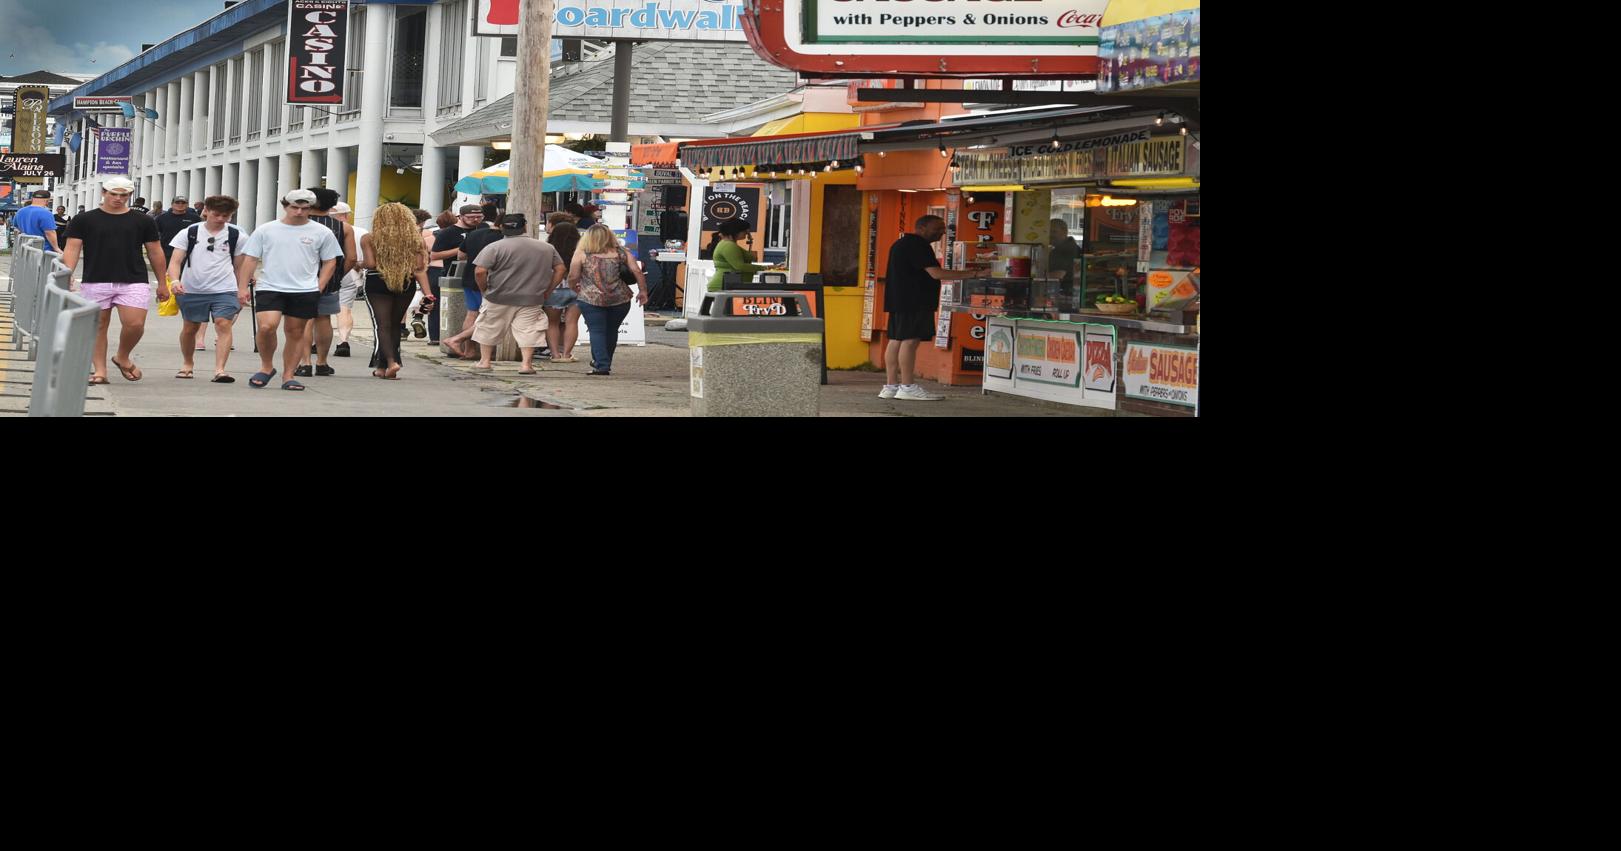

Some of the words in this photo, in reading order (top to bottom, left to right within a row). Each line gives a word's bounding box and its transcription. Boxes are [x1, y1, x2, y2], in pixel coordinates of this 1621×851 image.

[551, 2, 744, 30] oardwal
[833, 13, 872, 25] with
[880, 13, 956, 27] Peppers
[963, 13, 976, 25] &
[983, 13, 1049, 25] Onions
[300, 11, 338, 93] CASINO
[1011, 144, 1034, 157] ICE
[1075, 130, 1146, 151] LEMONADE
[1110, 142, 1140, 174] ITALIAN
[1143, 140, 1180, 172] SAUSAGE
[0, 154, 38, 163] Lauren
[3, 163, 44, 171] Alaina
[724, 193, 741, 201] THE
[1085, 340, 1113, 377] PIZZA
[1149, 350, 1198, 386] SAUSAGE
[1052, 367, 1063, 378] ROLL
